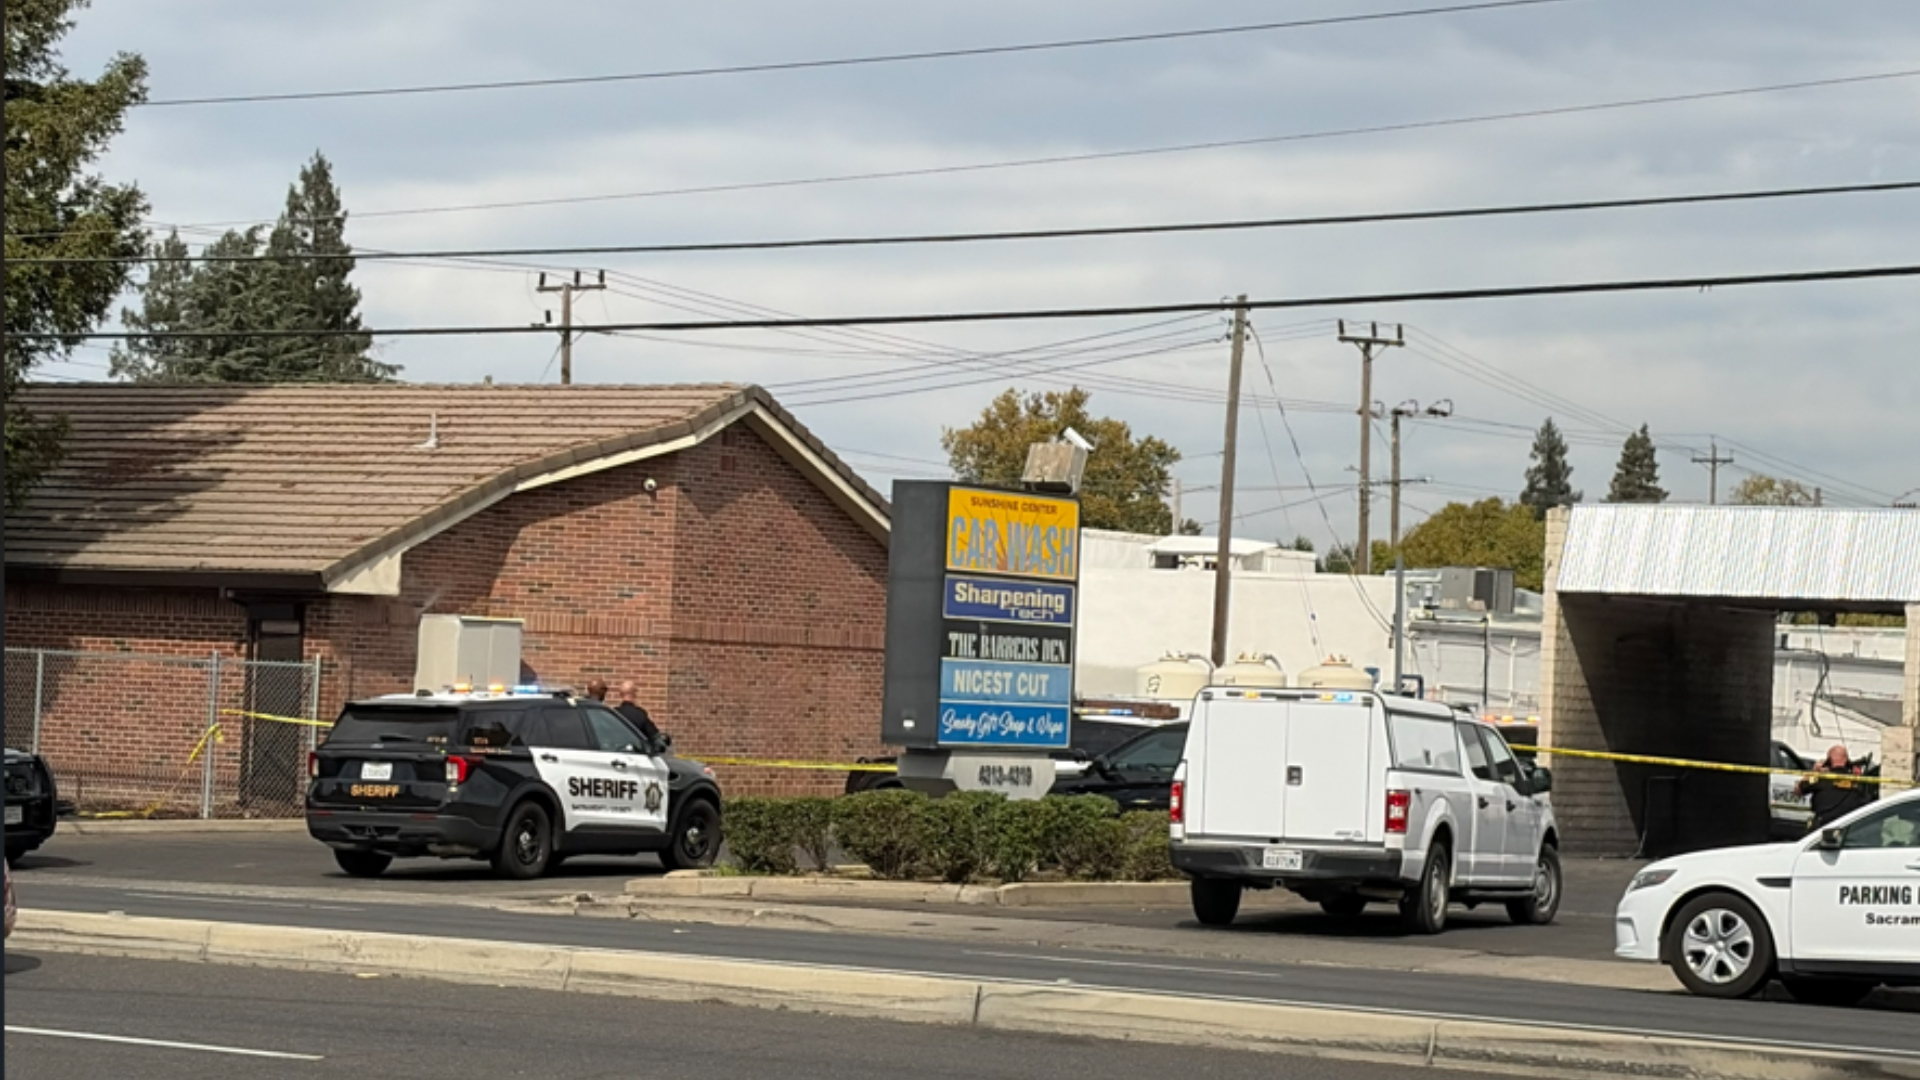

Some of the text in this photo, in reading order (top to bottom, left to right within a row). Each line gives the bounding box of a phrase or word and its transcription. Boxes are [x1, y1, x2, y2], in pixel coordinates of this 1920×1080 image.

[970, 496, 1058, 515] SUNSHINE CENTER
[950, 515, 1075, 577] CAR WASH
[954, 582, 1065, 614] Sharpening
[1010, 606, 1055, 620] Tech
[948, 632, 978, 658] THE
[1041, 637, 1066, 663] DEN
[953, 669, 1050, 697] NICEST CUT
[1027, 717, 1034, 734] &
[350, 784, 401, 798] SHERIFF
[567, 776, 638, 801] SHERIFF
[1839, 886, 1912, 905] PARKING
